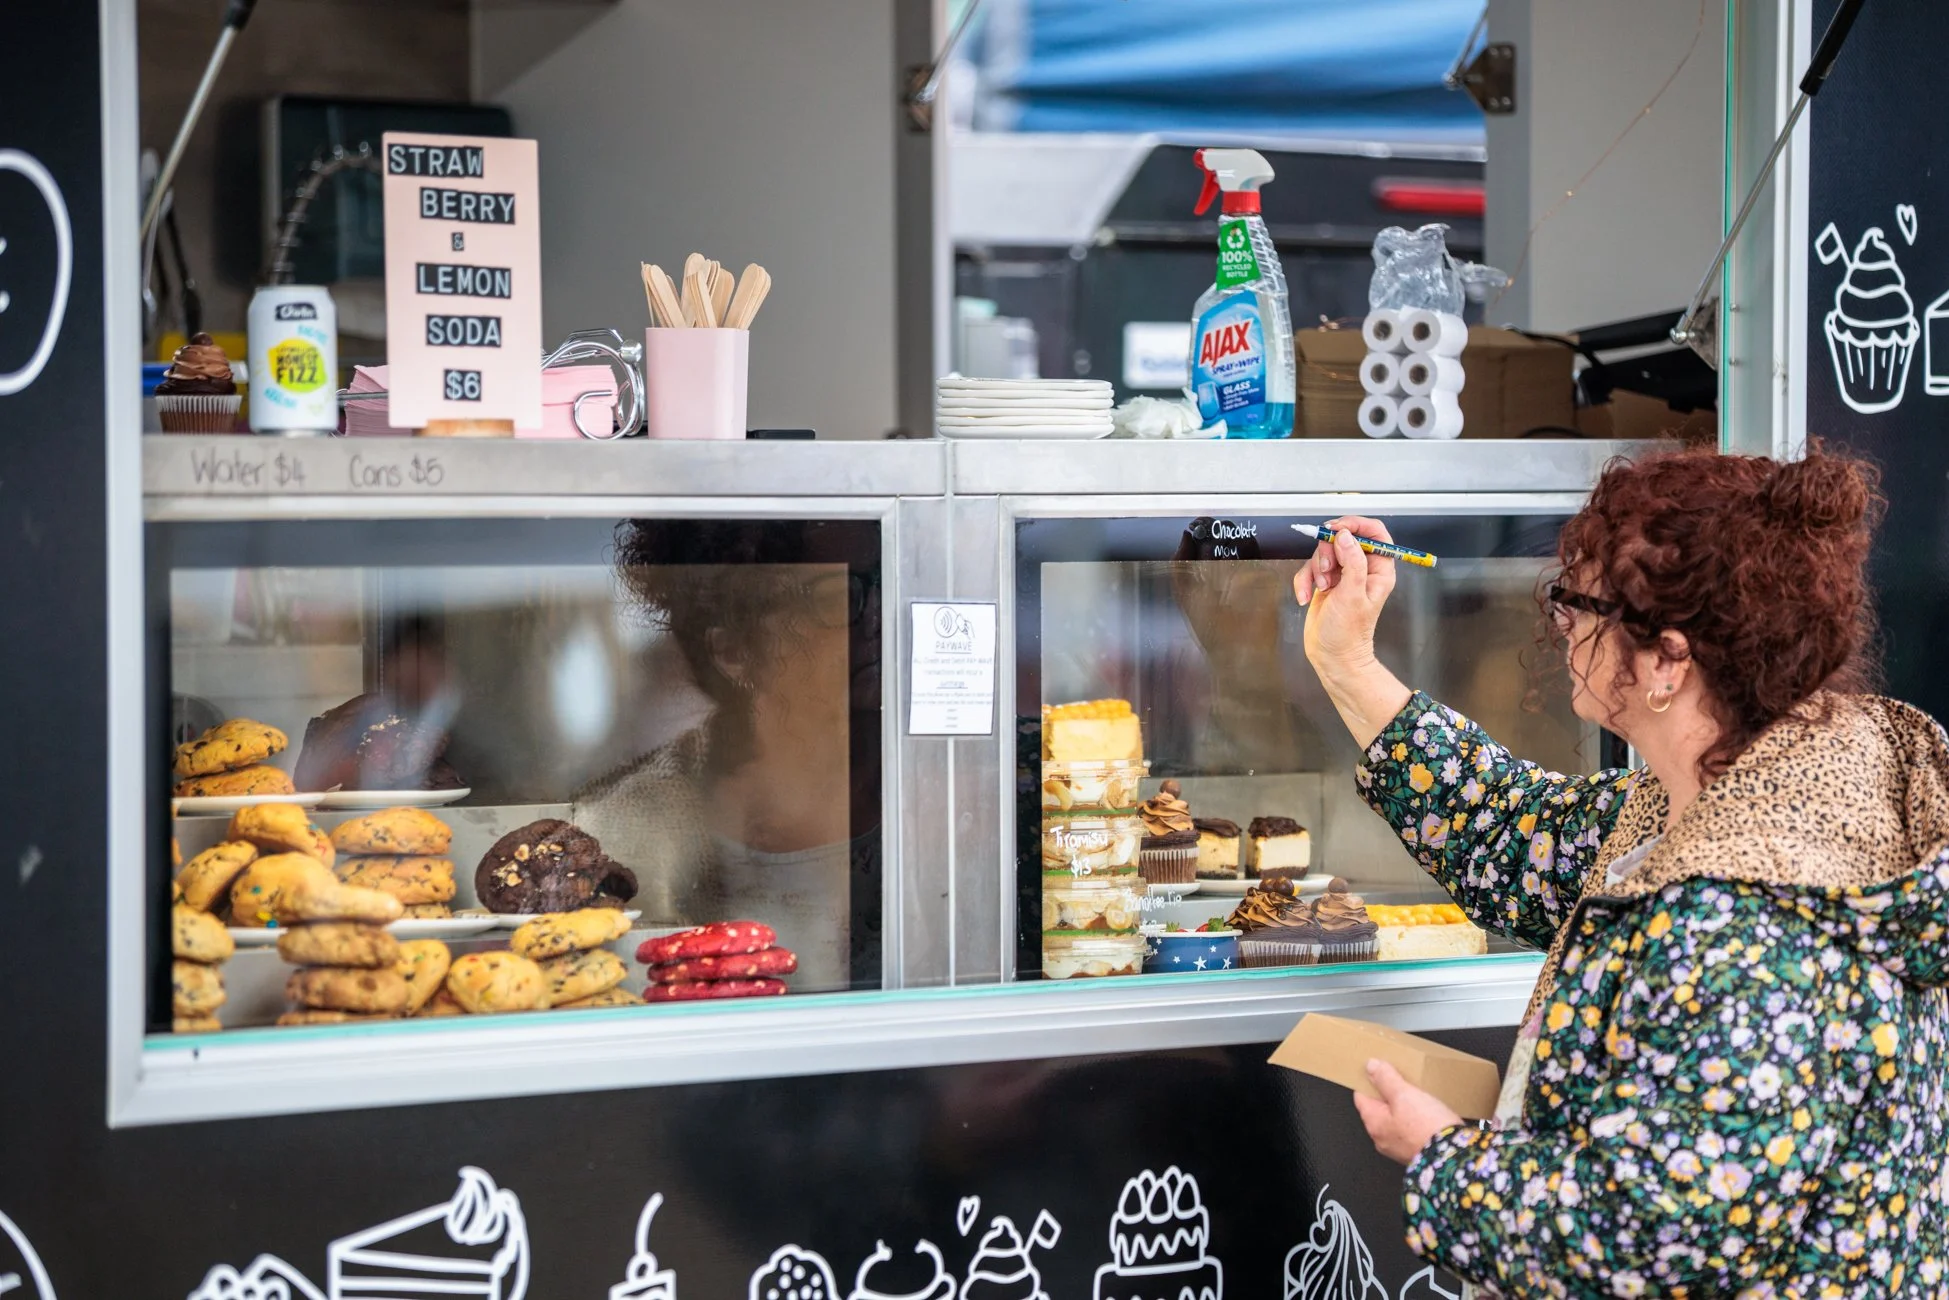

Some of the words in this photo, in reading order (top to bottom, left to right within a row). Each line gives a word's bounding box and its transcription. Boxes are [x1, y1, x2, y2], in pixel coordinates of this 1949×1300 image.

[389, 145, 484, 177] STRAW
[422, 189, 515, 223] BERRY
[453, 233, 464, 250] &
[1221, 250, 1253, 264] 100%
[418, 265, 511, 297] LEMON
[427, 316, 501, 346] SODA
[1200, 320, 1251, 368] AJAX
[276, 366, 318, 385] FIZZ
[445, 370, 481, 400] $6
[1223, 381, 1251, 396] GLASS
[191, 446, 265, 486] Water
[274, 452, 306, 488] $4
[350, 454, 401, 488] Cans
[408, 452, 446, 486] $5
[1211, 519, 1257, 540] Chocolate
[935, 641, 973, 651] PAYWAVE
